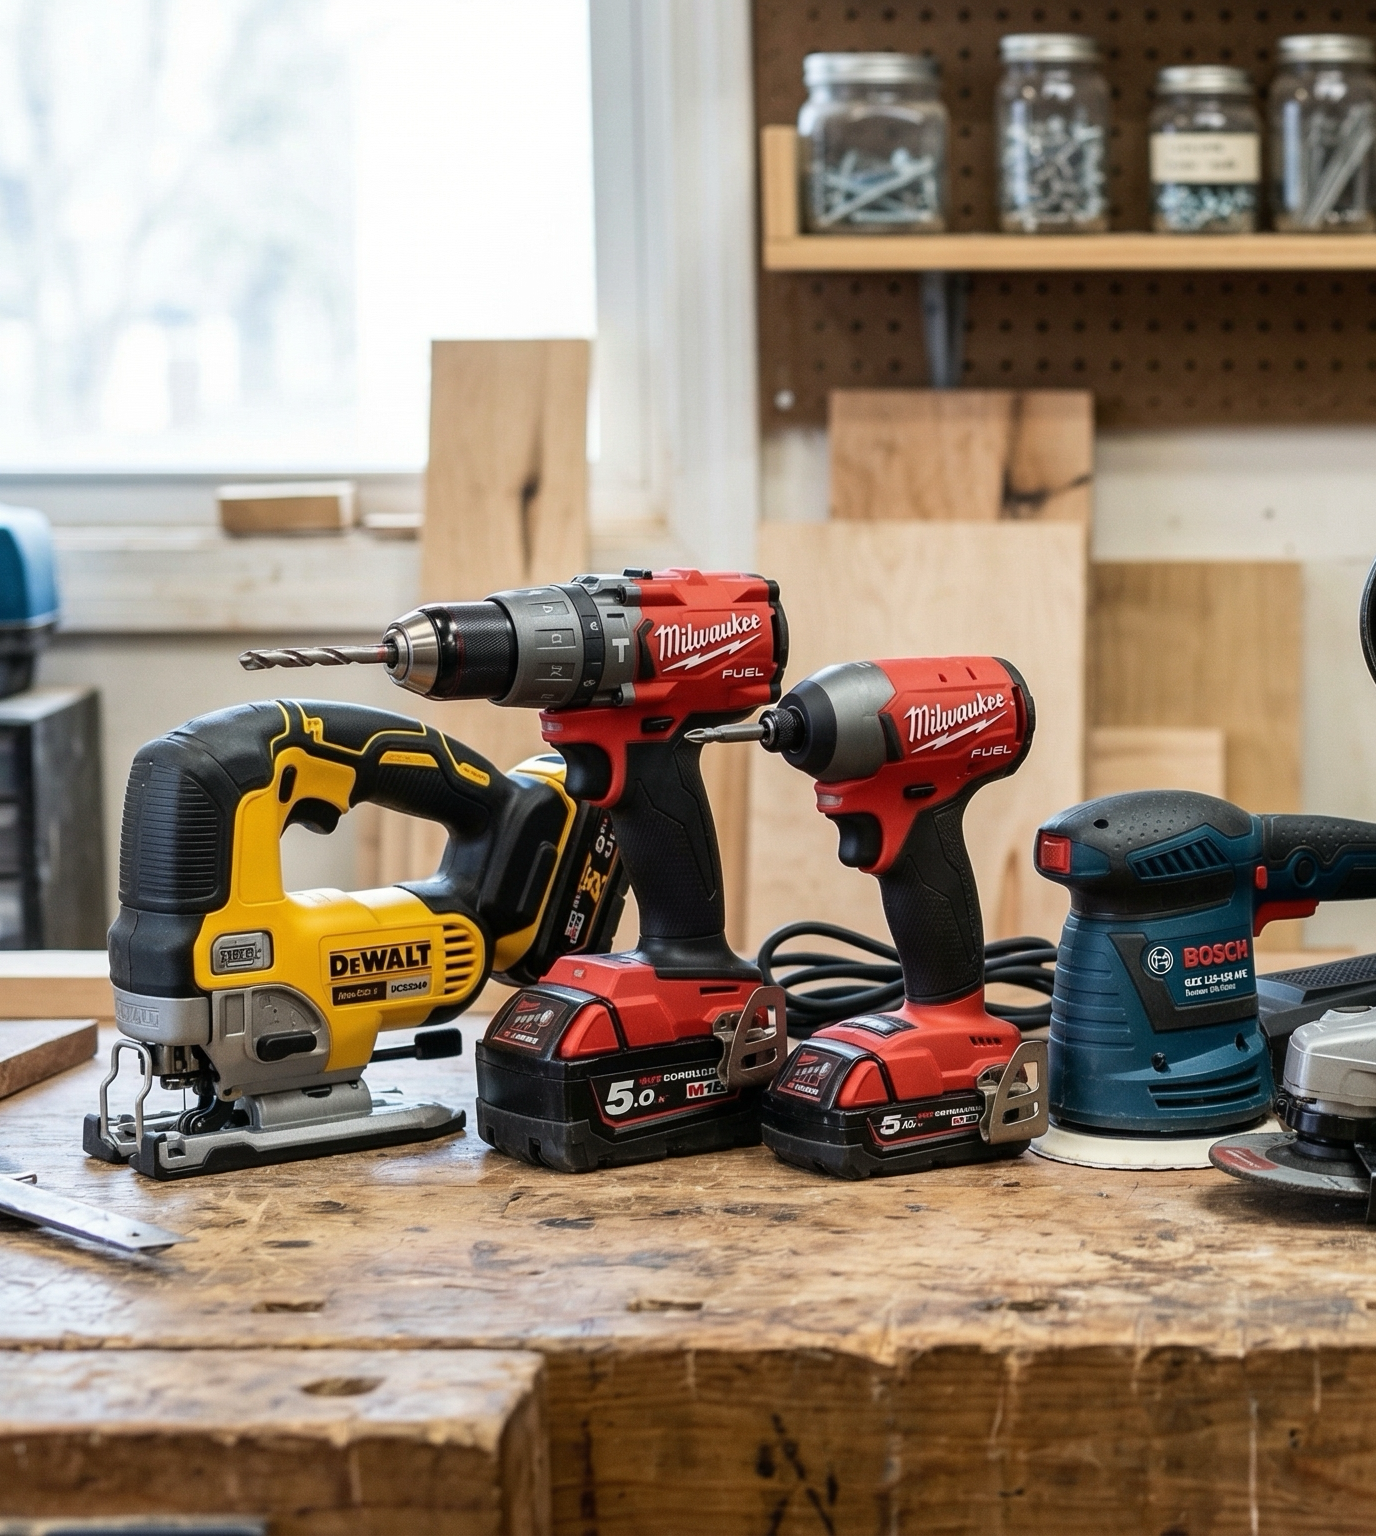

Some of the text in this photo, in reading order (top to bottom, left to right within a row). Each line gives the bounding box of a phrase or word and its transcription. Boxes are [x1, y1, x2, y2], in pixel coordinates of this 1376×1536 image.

[654, 612, 762, 661] Milwaukee
[722, 667, 764, 679] FUEL
[903, 692, 1008, 743] Milwaukee
[971, 745, 1012, 759] FUEL
[1183, 939, 1249, 969] BOSCH
[604, 1079, 655, 1115] 5.0
